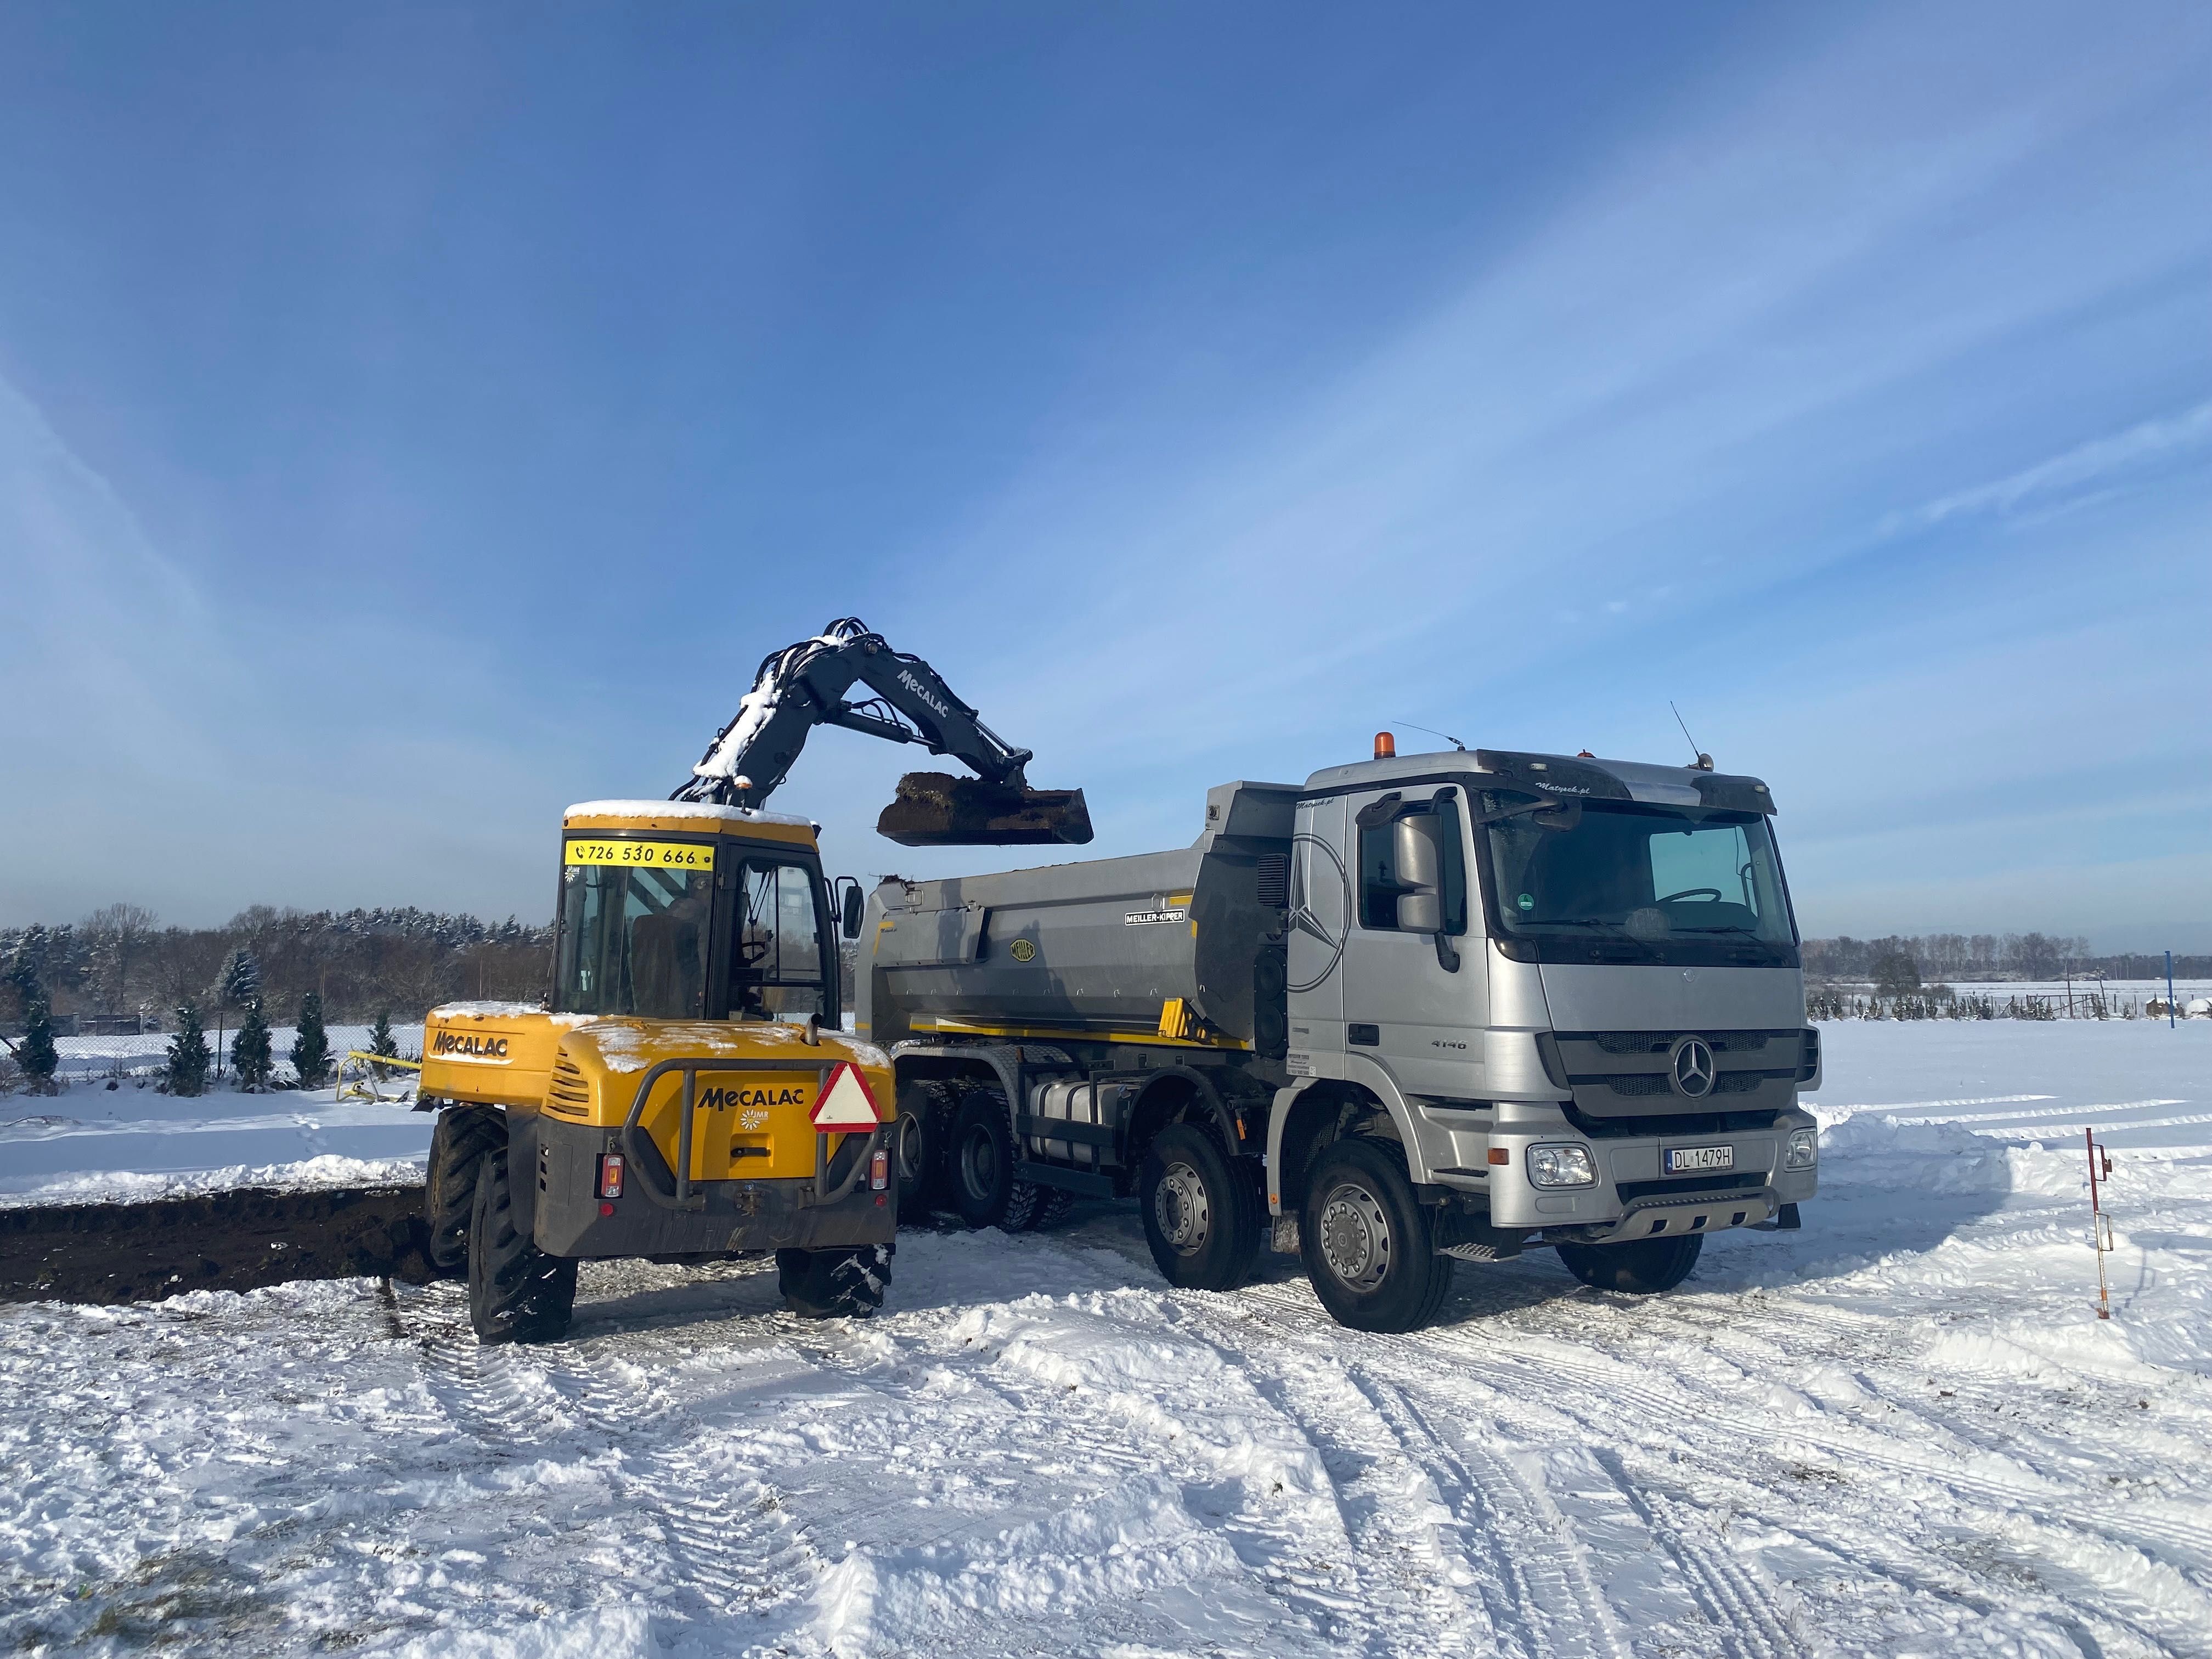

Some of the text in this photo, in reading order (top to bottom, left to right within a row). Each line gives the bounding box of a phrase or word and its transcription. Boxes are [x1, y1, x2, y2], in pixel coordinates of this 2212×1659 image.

[1535, 782, 1590, 794] Matysek.pl
[1296, 798, 1334, 809] Matysek.pl
[588, 847, 695, 864] 726 530 666
[1126, 912, 1183, 923] MEILLER-KIPPER
[1431, 1041, 1466, 1049] 4146
[1675, 1148, 1730, 1169] DL 1479H
